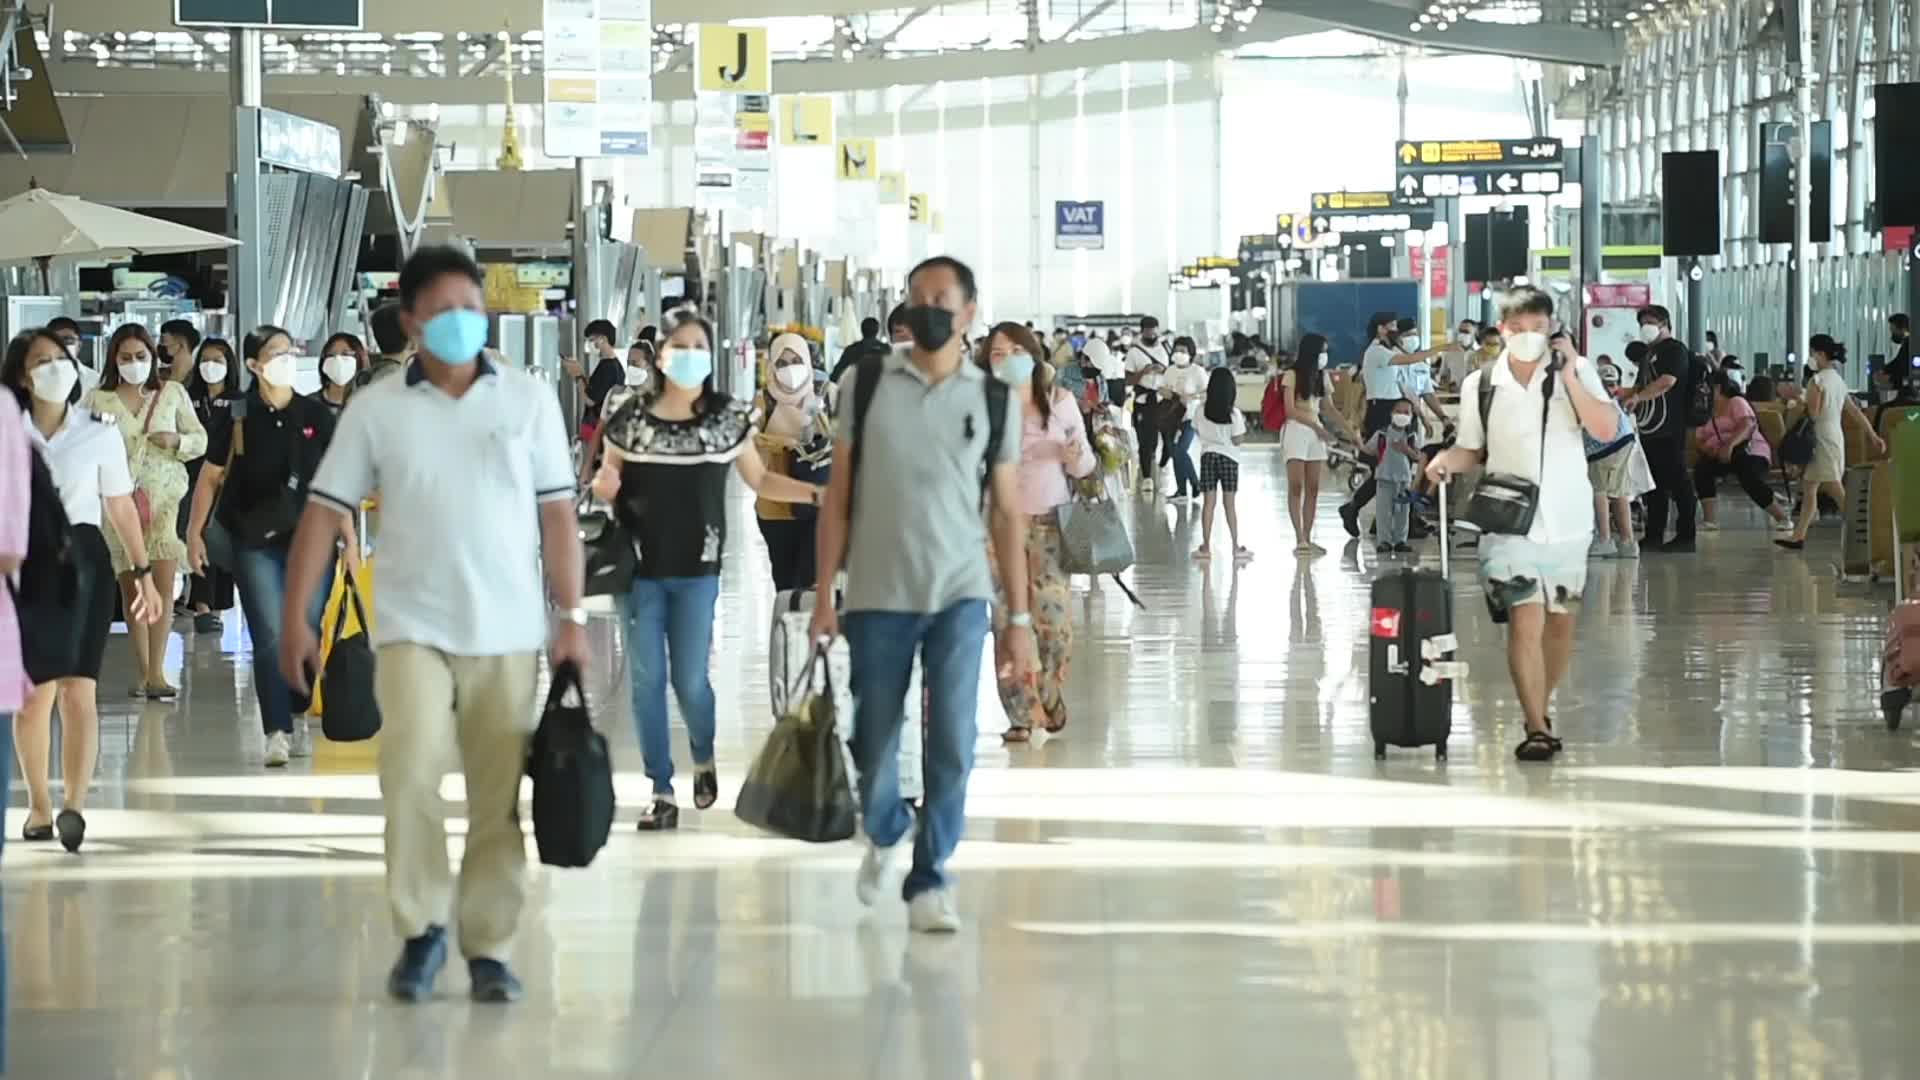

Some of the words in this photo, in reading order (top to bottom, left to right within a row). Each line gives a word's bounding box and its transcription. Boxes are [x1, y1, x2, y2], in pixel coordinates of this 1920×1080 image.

[718, 32, 747, 82] J
[793, 102, 818, 141] L
[1061, 206, 1097, 223] VAT
